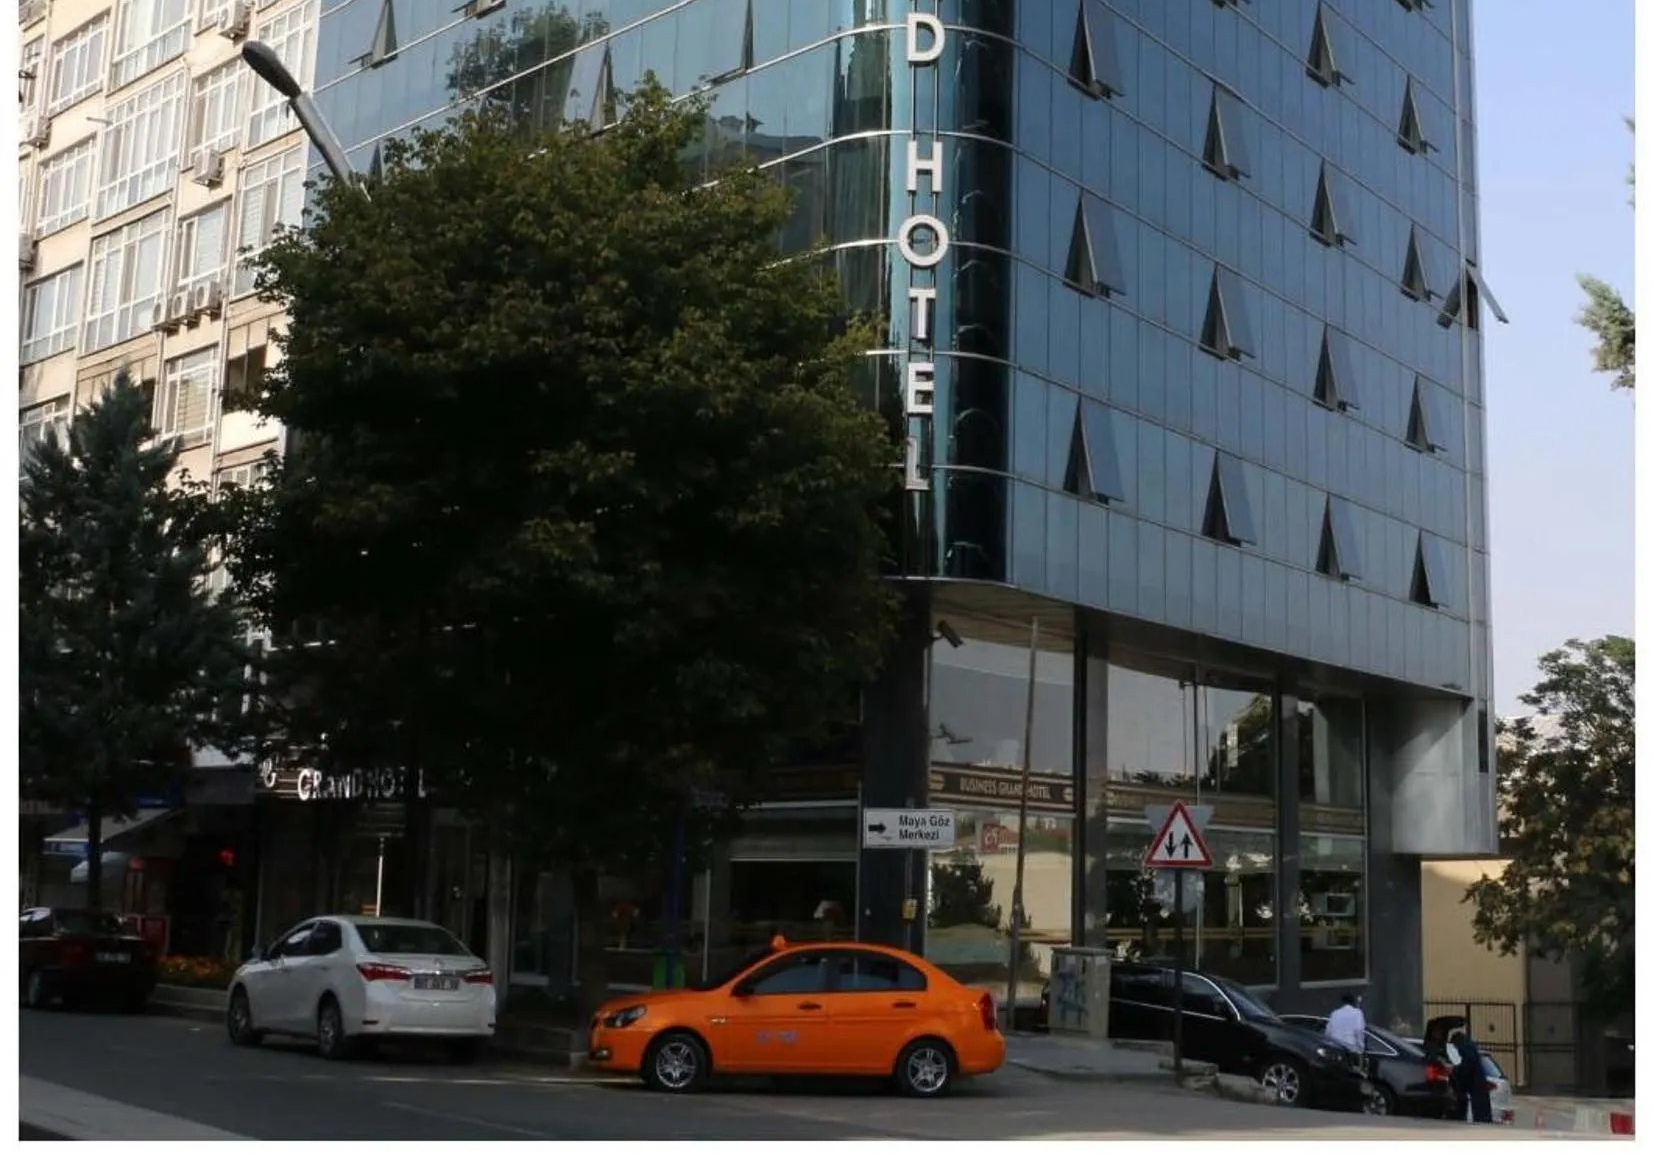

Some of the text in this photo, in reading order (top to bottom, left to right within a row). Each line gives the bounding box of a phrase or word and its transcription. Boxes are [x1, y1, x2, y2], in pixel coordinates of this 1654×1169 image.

[898, 140, 949, 491] HOTEL
[898, 815, 951, 828] Maya Göz
[898, 829, 940, 840] Merkezi
